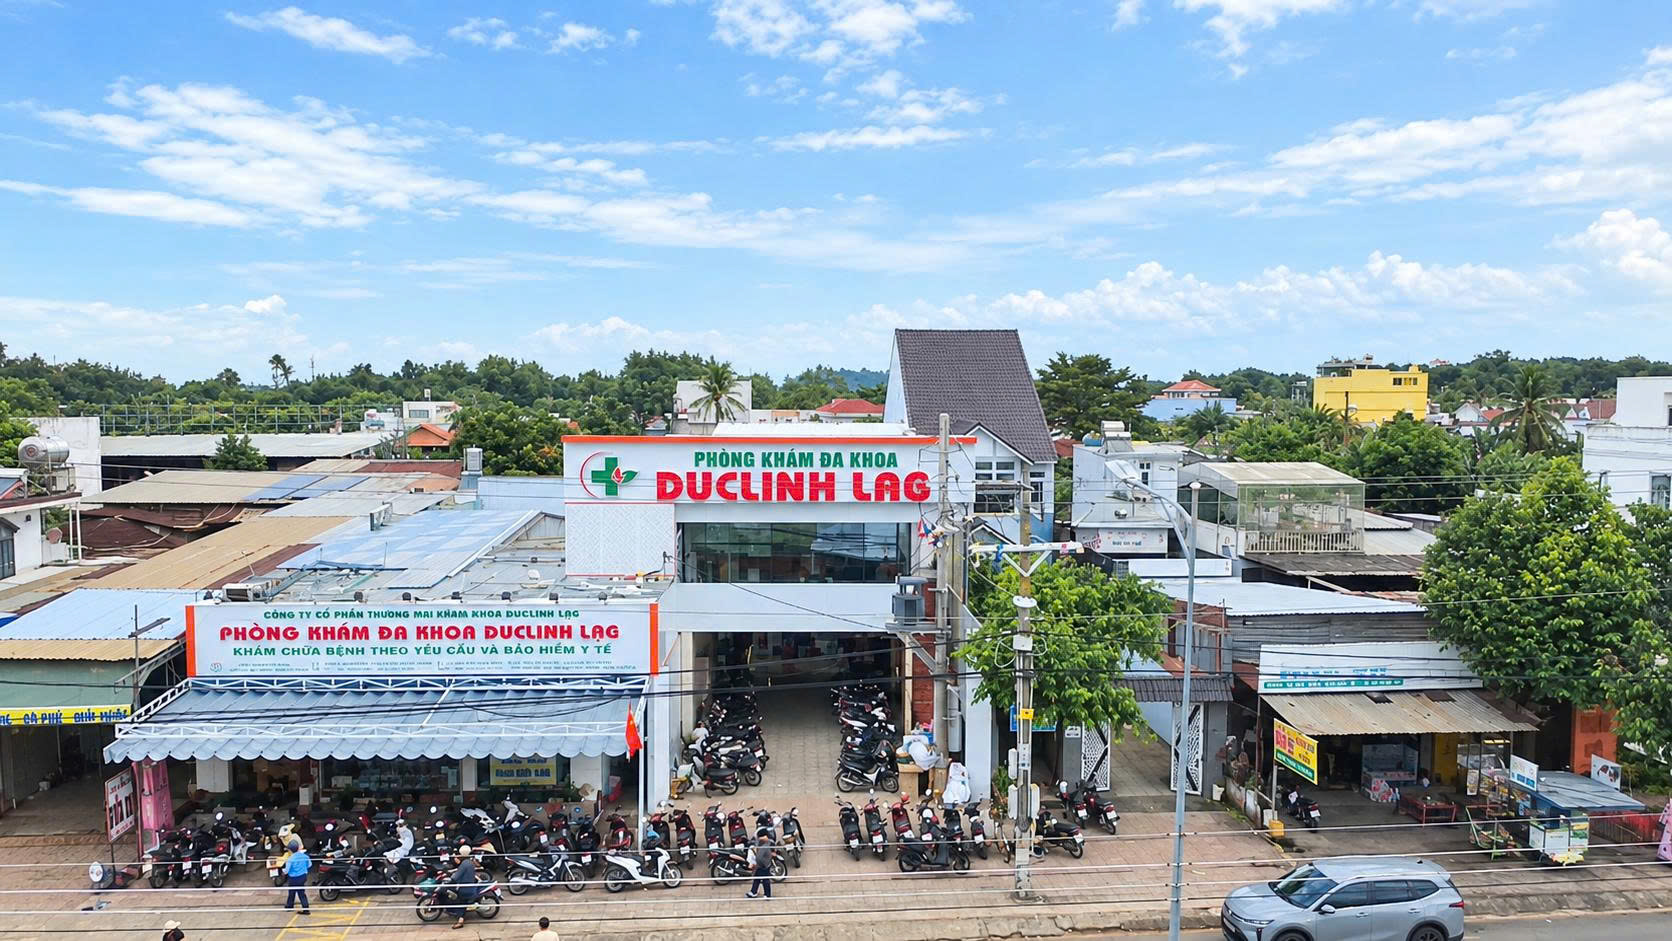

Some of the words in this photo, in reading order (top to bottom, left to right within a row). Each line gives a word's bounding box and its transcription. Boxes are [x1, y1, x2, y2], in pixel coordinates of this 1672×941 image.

[694, 448, 755, 468] PHÒNG
[761, 448, 814, 468] KHÁM
[819, 451, 844, 468] ĐA
[850, 451, 898, 468] KHOA
[656, 471, 836, 502] DUCLINH
[852, 471, 931, 502] LAG
[298, 610, 312, 619] TY
[471, 610, 502, 619] KHOA
[505, 610, 554, 618] DUCLINH
[219, 622, 299, 641] PHÒNG
[308, 622, 370, 641] KHÁM
[377, 625, 408, 640] ĐA
[415, 625, 476, 640] KHOA
[484, 625, 573, 640] DUCLINH
[580, 624, 619, 642] LẠG
[233, 645, 276, 656] KHÁM
[281, 645, 321, 656] CHỮA
[370, 646, 408, 655] THEO
[480, 643, 499, 655] VÀ
[580, 645, 589, 654] Y
